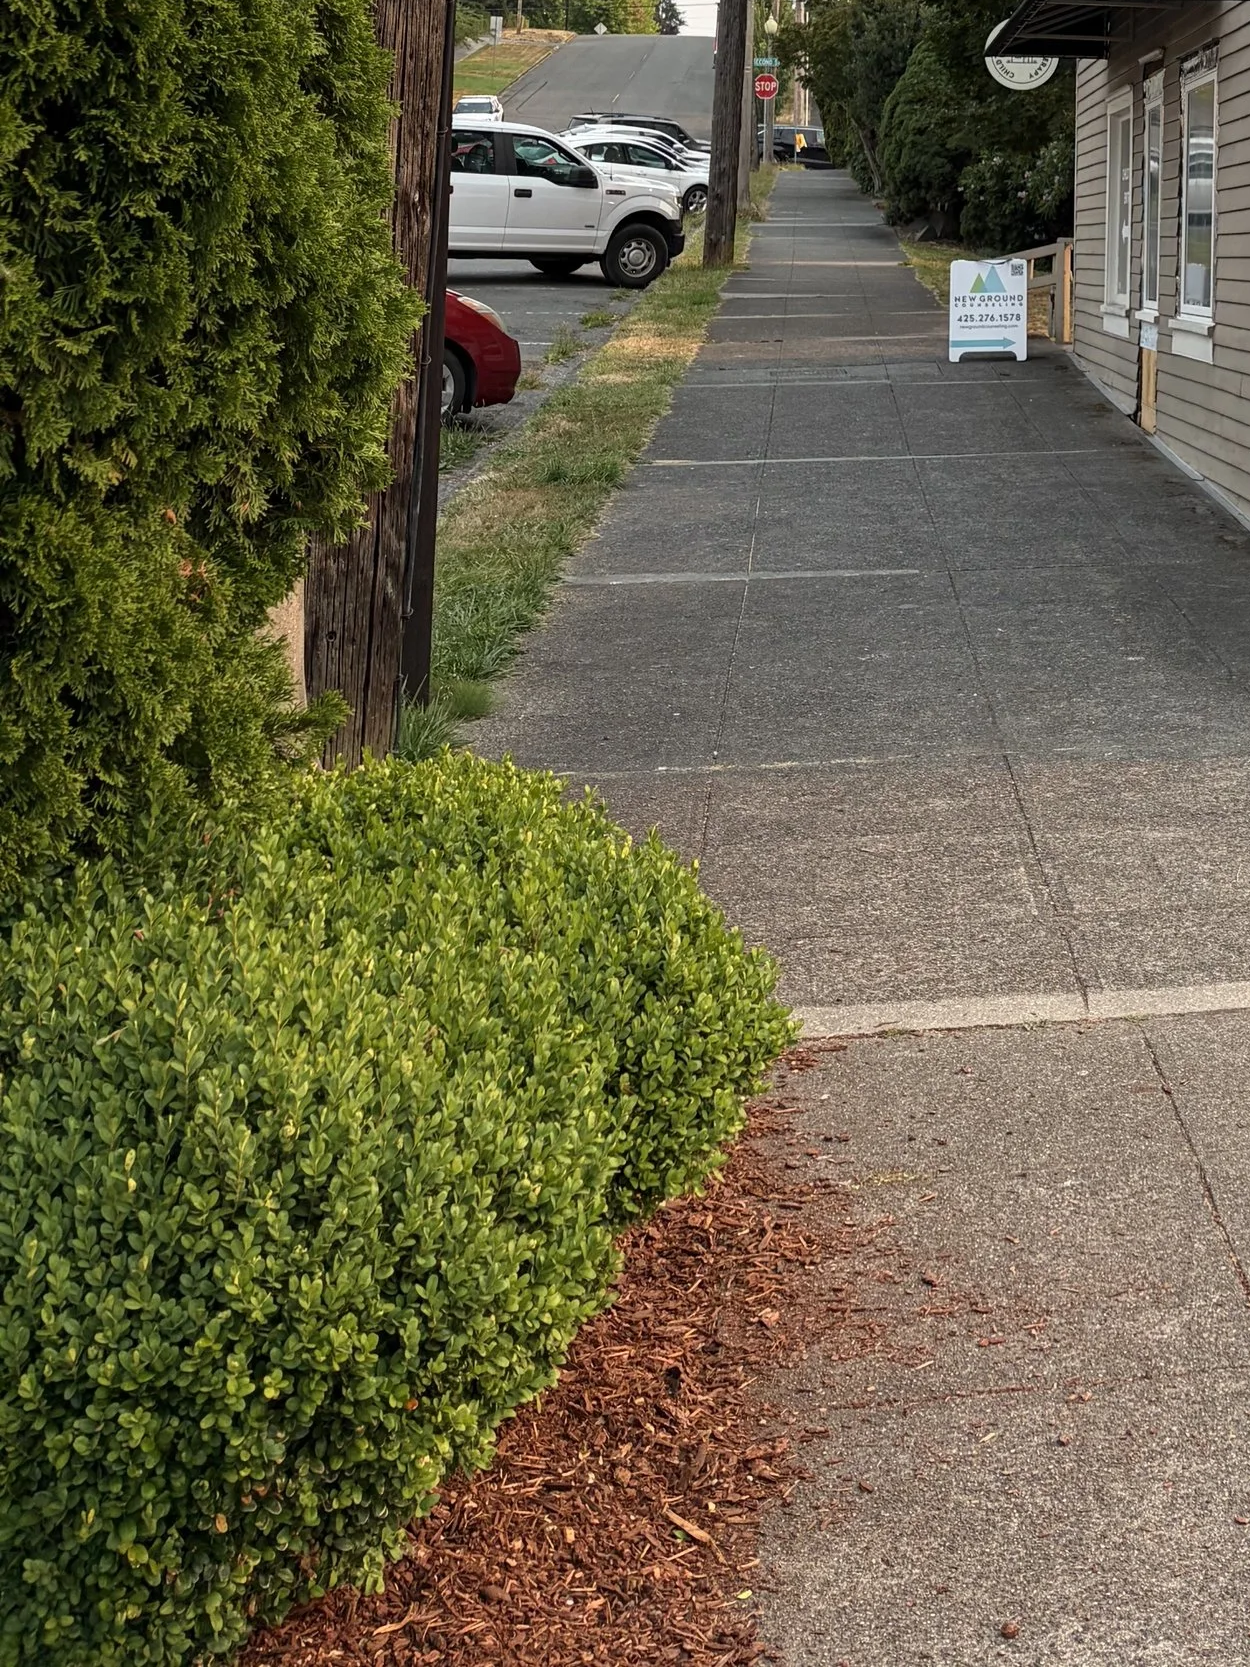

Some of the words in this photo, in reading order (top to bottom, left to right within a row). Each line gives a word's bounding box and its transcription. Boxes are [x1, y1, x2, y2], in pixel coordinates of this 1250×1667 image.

[995, 59, 1015, 79] CHILD
[755, 81, 777, 92] STOP
[979, 294, 1024, 302] GROUND
[957, 313, 1022, 322] 425.276.1578
